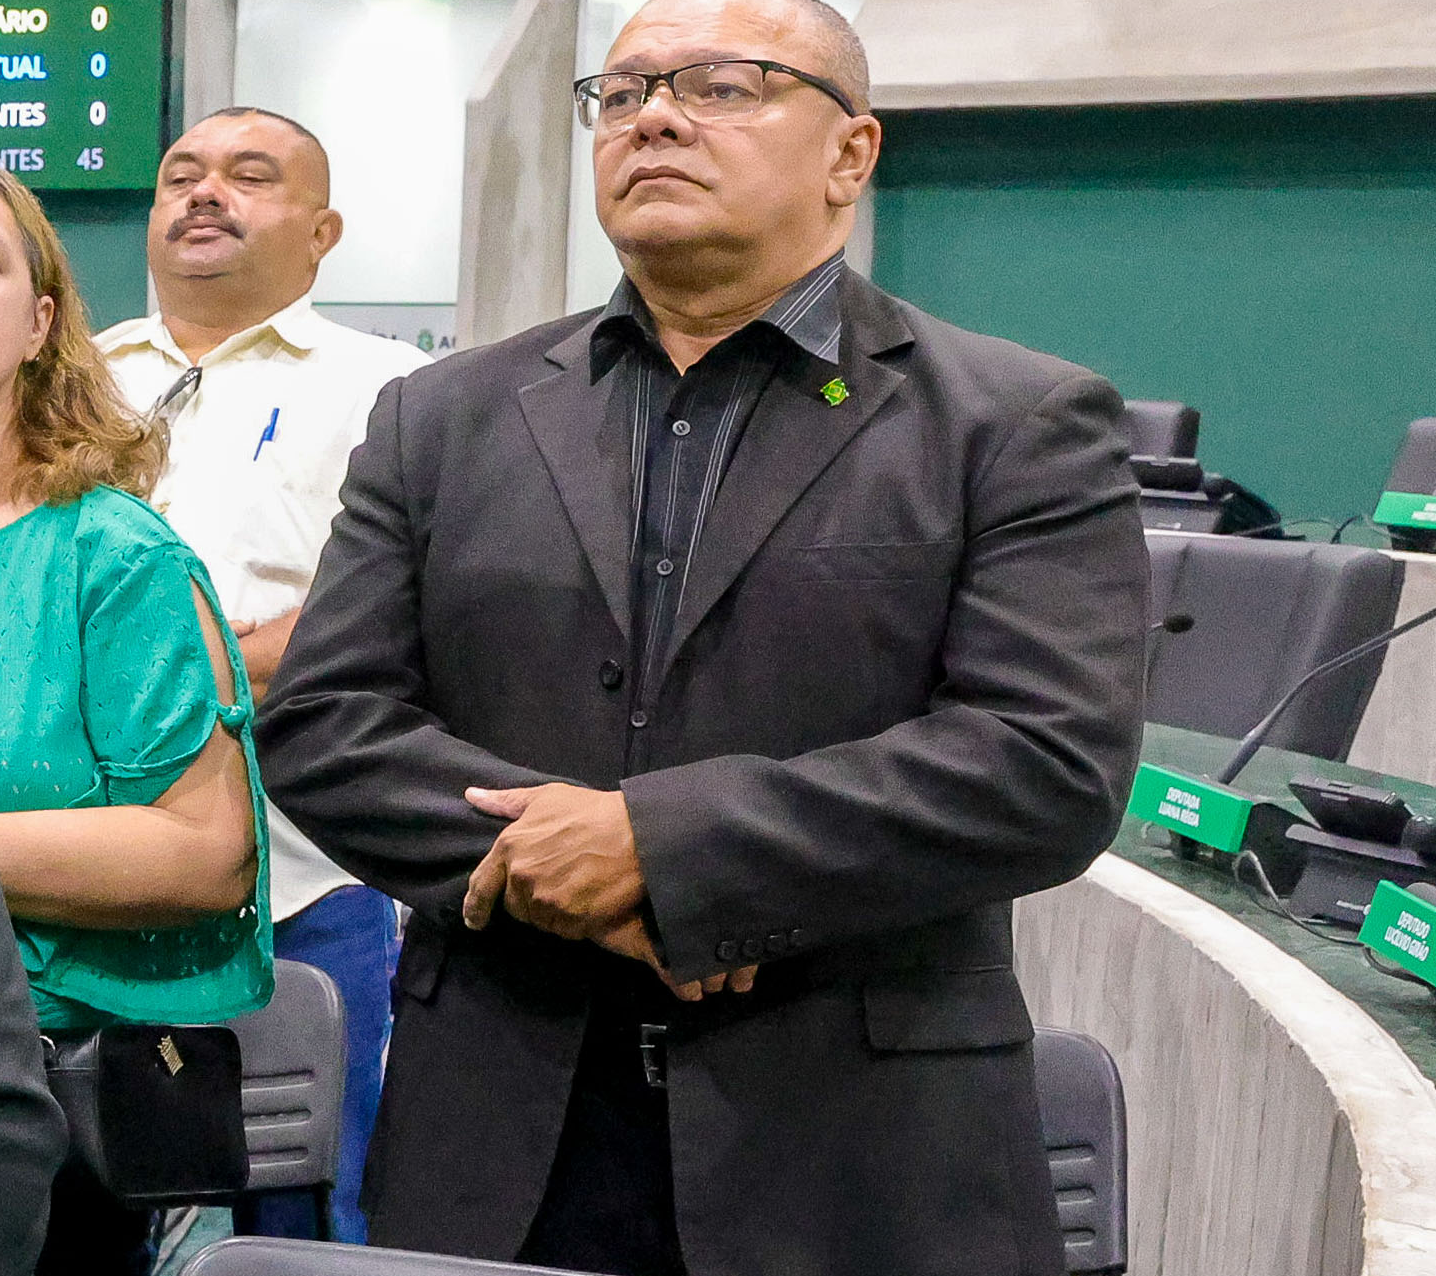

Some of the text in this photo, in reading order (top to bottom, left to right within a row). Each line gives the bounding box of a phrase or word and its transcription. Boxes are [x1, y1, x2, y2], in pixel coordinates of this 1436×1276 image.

[90, 5, 109, 32] 0
[90, 53, 106, 78] 0
[89, 100, 107, 126] 0
[76, 147, 104, 170] 45
